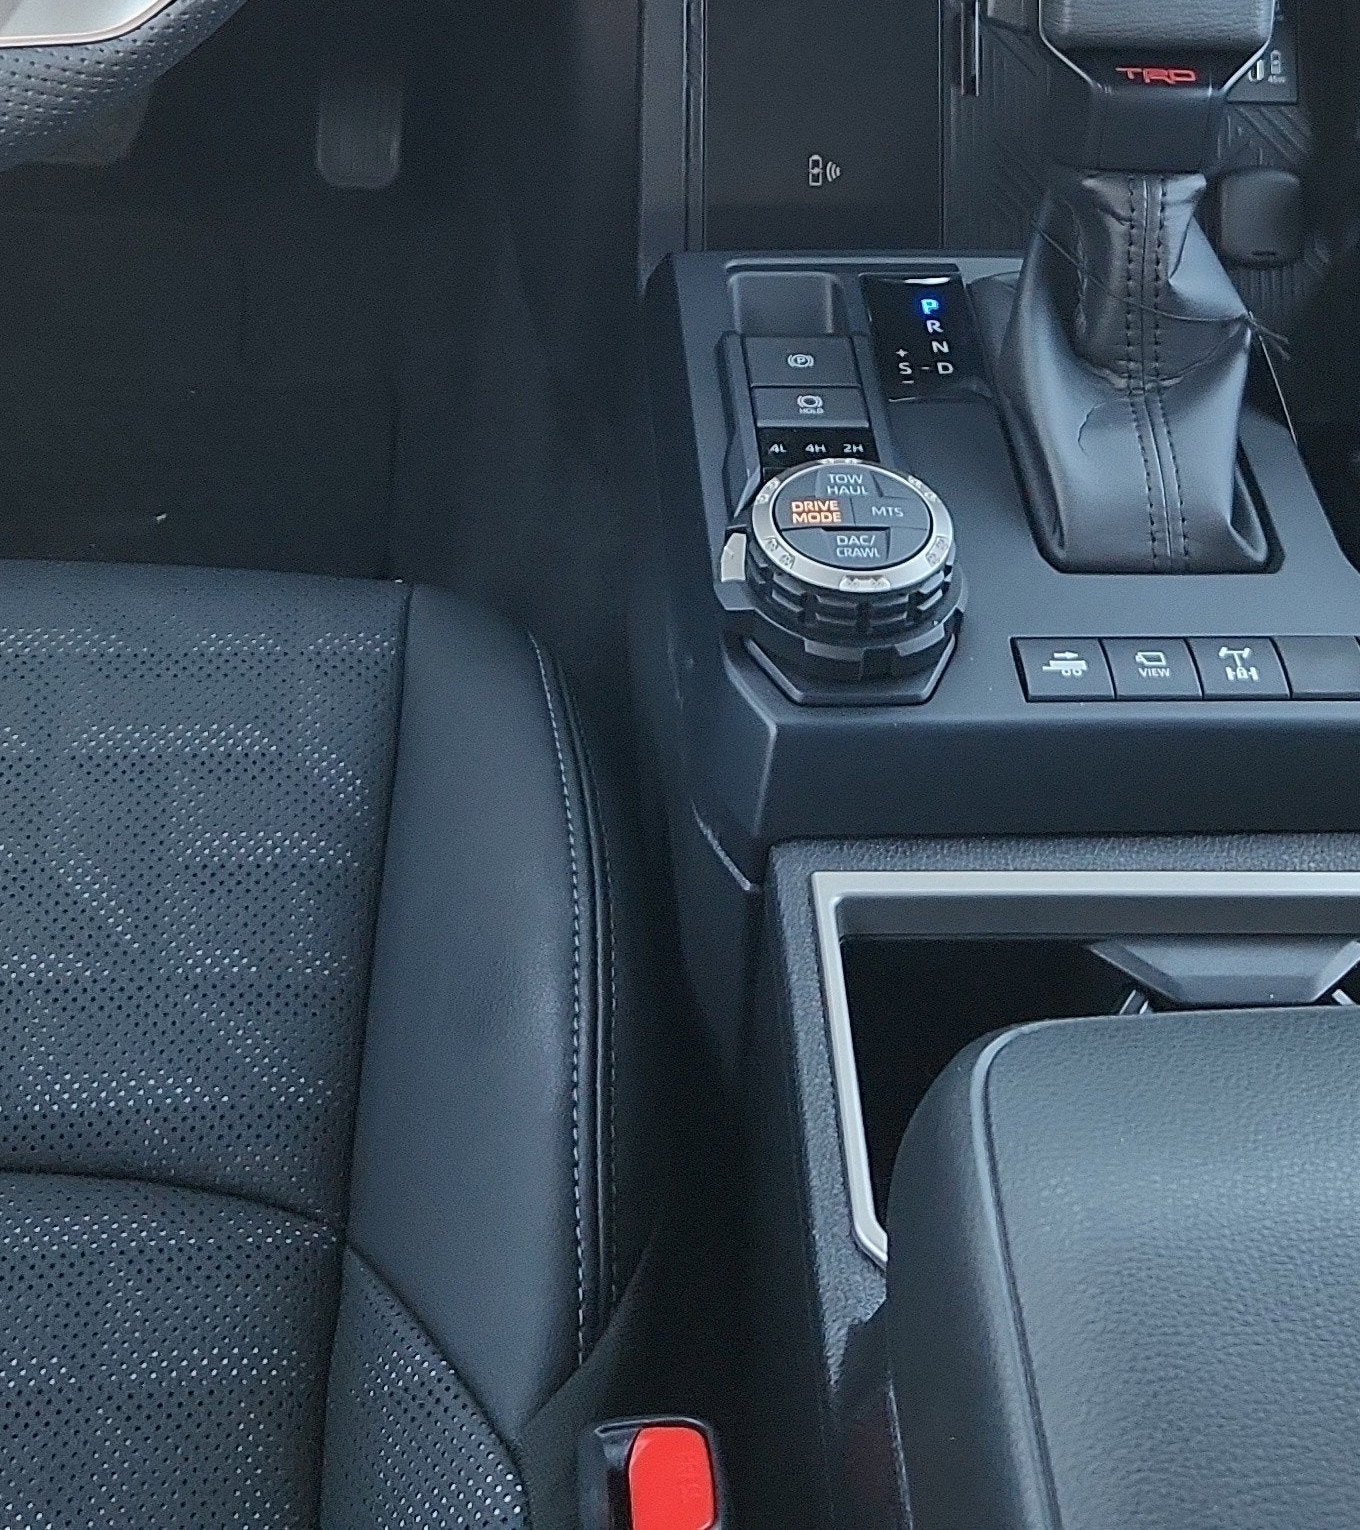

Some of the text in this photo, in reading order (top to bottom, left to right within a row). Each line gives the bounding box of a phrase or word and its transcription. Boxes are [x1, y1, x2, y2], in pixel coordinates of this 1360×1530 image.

[1115, 67, 1196, 84] TRD
[921, 298, 939, 314] P
[926, 320, 944, 333] R
[932, 341, 949, 354] N
[898, 362, 954, 375] S D
[769, 443, 864, 454] 4L 4H 2H
[828, 473, 863, 484] TOW
[826, 485, 869, 495] HAUL
[792, 500, 839, 512] DRIVE
[872, 506, 904, 517] MTS
[792, 512, 842, 524] MODE
[836, 535, 876, 547] DAC/
[836, 548, 880, 558] CRAWL
[1138, 668, 1170, 678] VIEW
